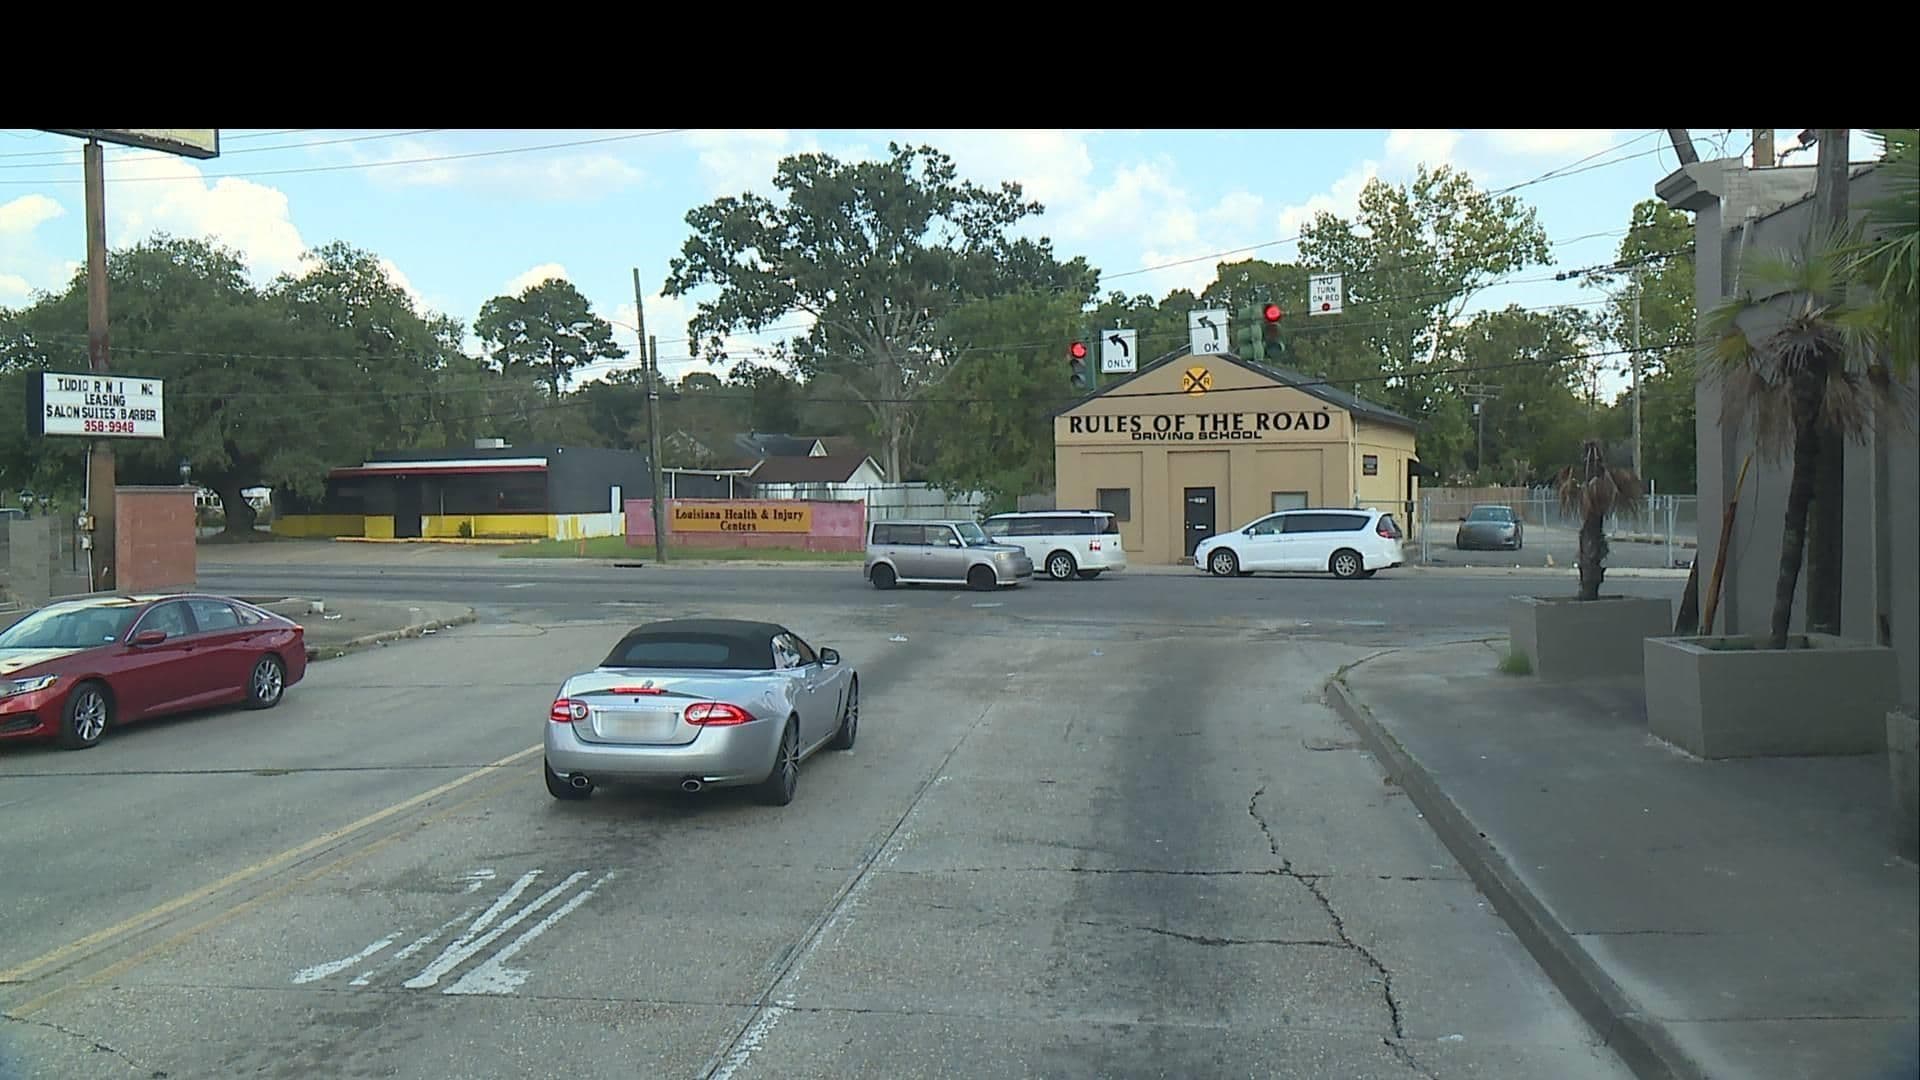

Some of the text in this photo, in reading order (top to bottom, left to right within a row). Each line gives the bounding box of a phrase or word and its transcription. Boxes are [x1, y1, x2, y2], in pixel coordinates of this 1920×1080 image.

[1204, 343, 1220, 353] OK
[1107, 359, 1132, 369] ONLY
[84, 393, 126, 407] LEASING
[46, 404, 80, 419] SALON
[82, 406, 116, 420] SUITES
[84, 420, 135, 433] 358-9948
[1070, 412, 1330, 433] RULES OF THE ROAD
[1131, 431, 1263, 440] DRIVING SCHOOL
[675, 508, 803, 521] Louisiana Health & Injury
[720, 520, 757, 531] Centers
